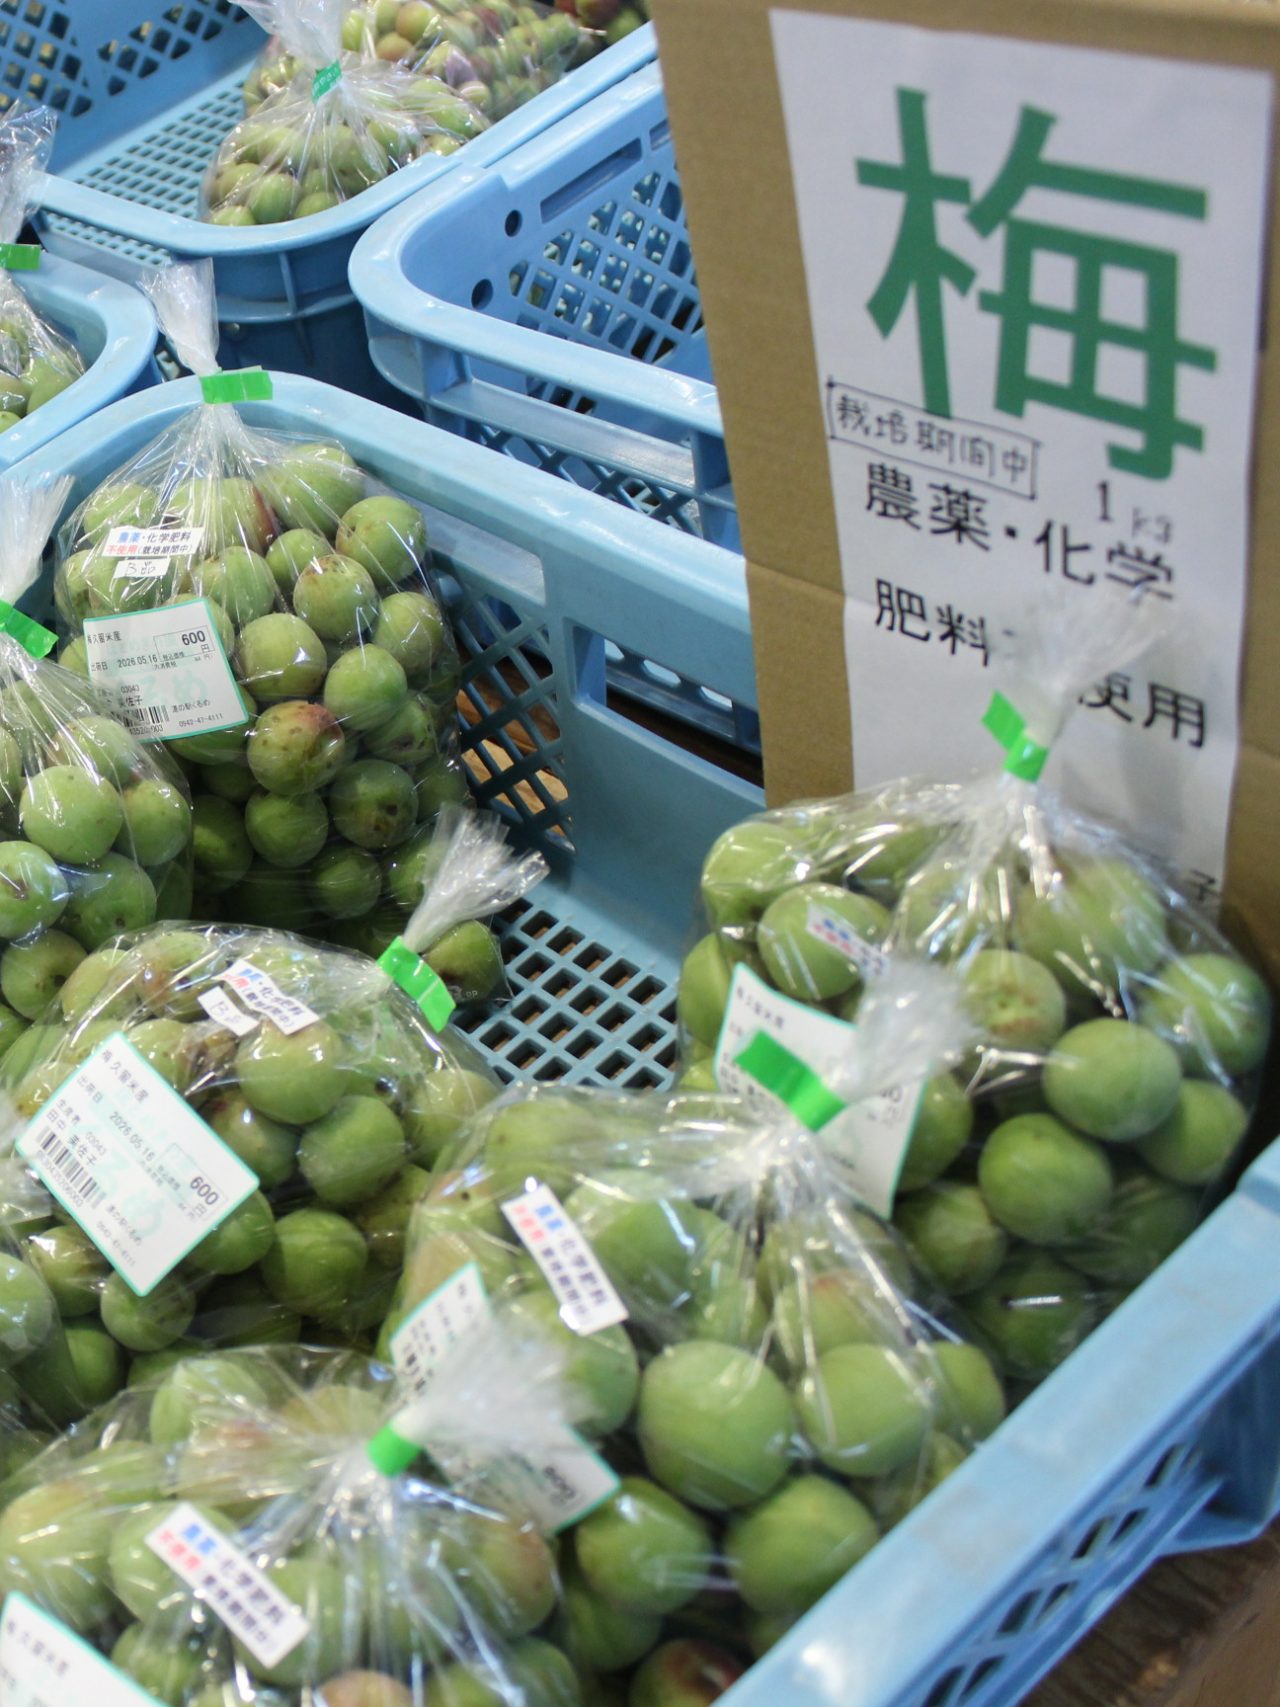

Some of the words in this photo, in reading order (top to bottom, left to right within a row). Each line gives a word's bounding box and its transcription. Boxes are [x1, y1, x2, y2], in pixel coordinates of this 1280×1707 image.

[855, 85, 1218, 484] 梅
[182, 631, 206, 646] 600
[117, 654, 157, 668] 2026.05.16
[109, 1111, 155, 1162] 2026.05.16
[190, 1176, 218, 1207] 600
